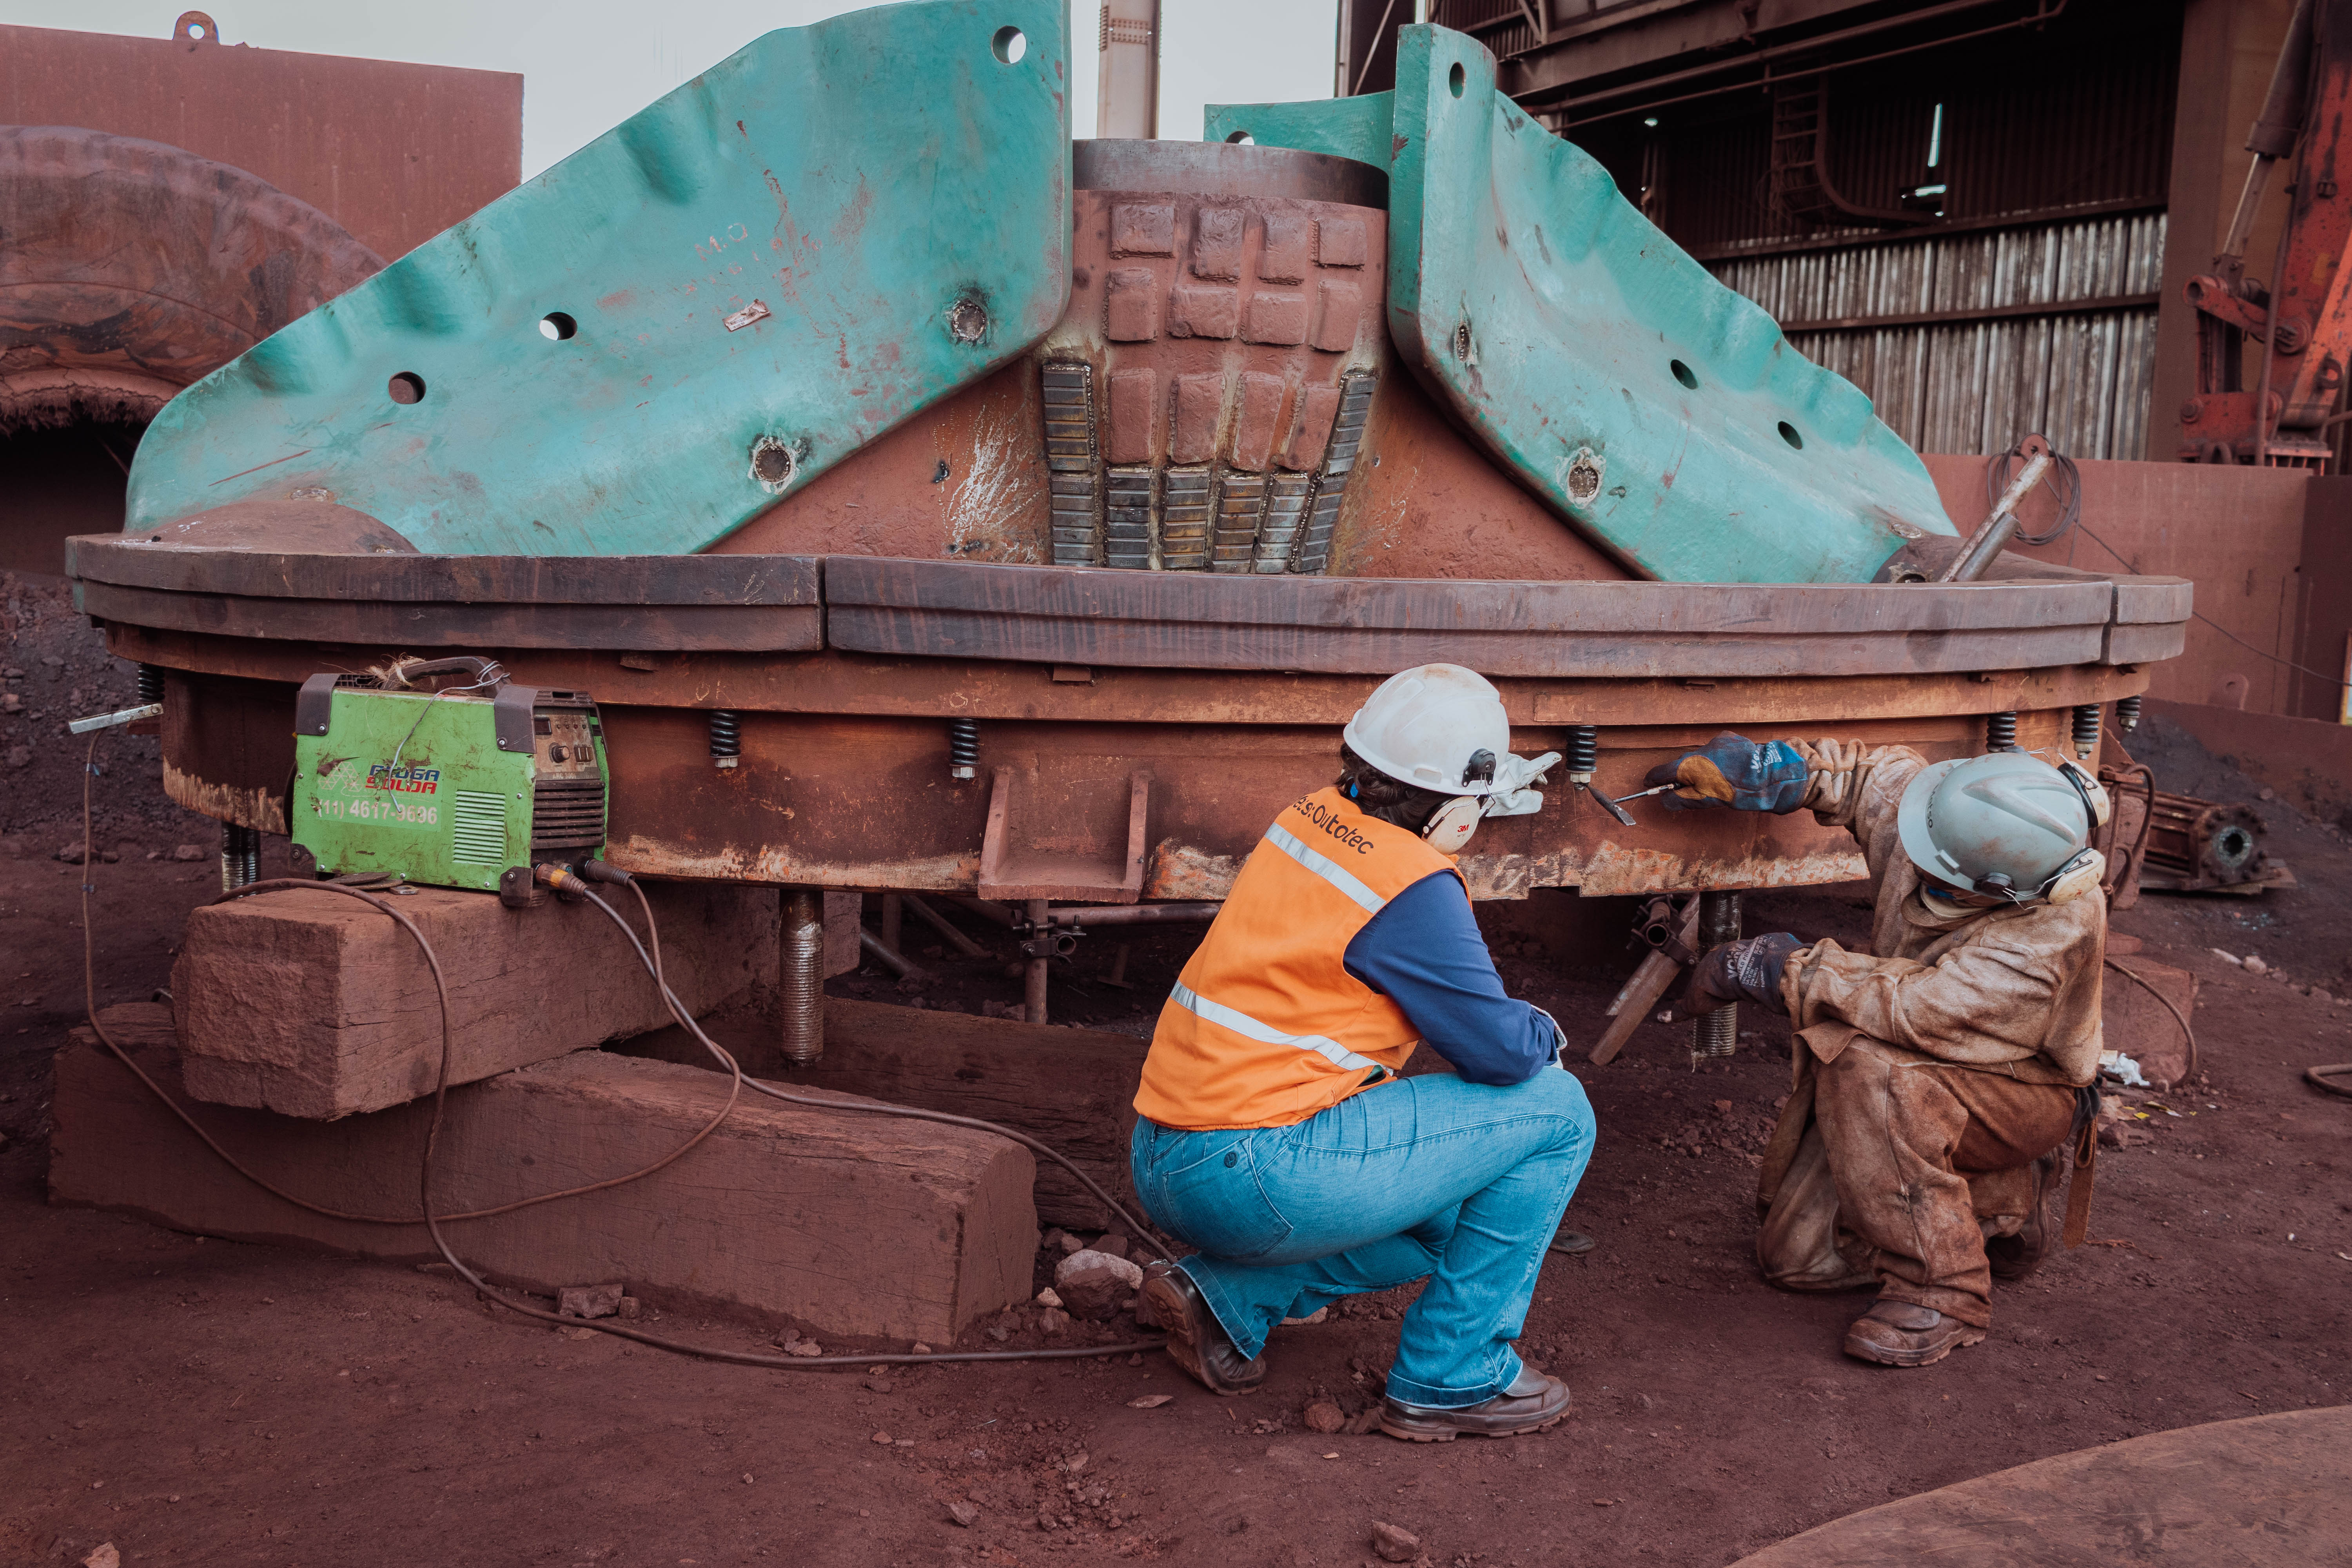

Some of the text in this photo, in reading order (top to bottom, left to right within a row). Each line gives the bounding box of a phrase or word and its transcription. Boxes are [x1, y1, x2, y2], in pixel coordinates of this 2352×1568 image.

[318, 799, 437, 825] (11) 4617-9696
[1457, 824, 1470, 832] 3M
